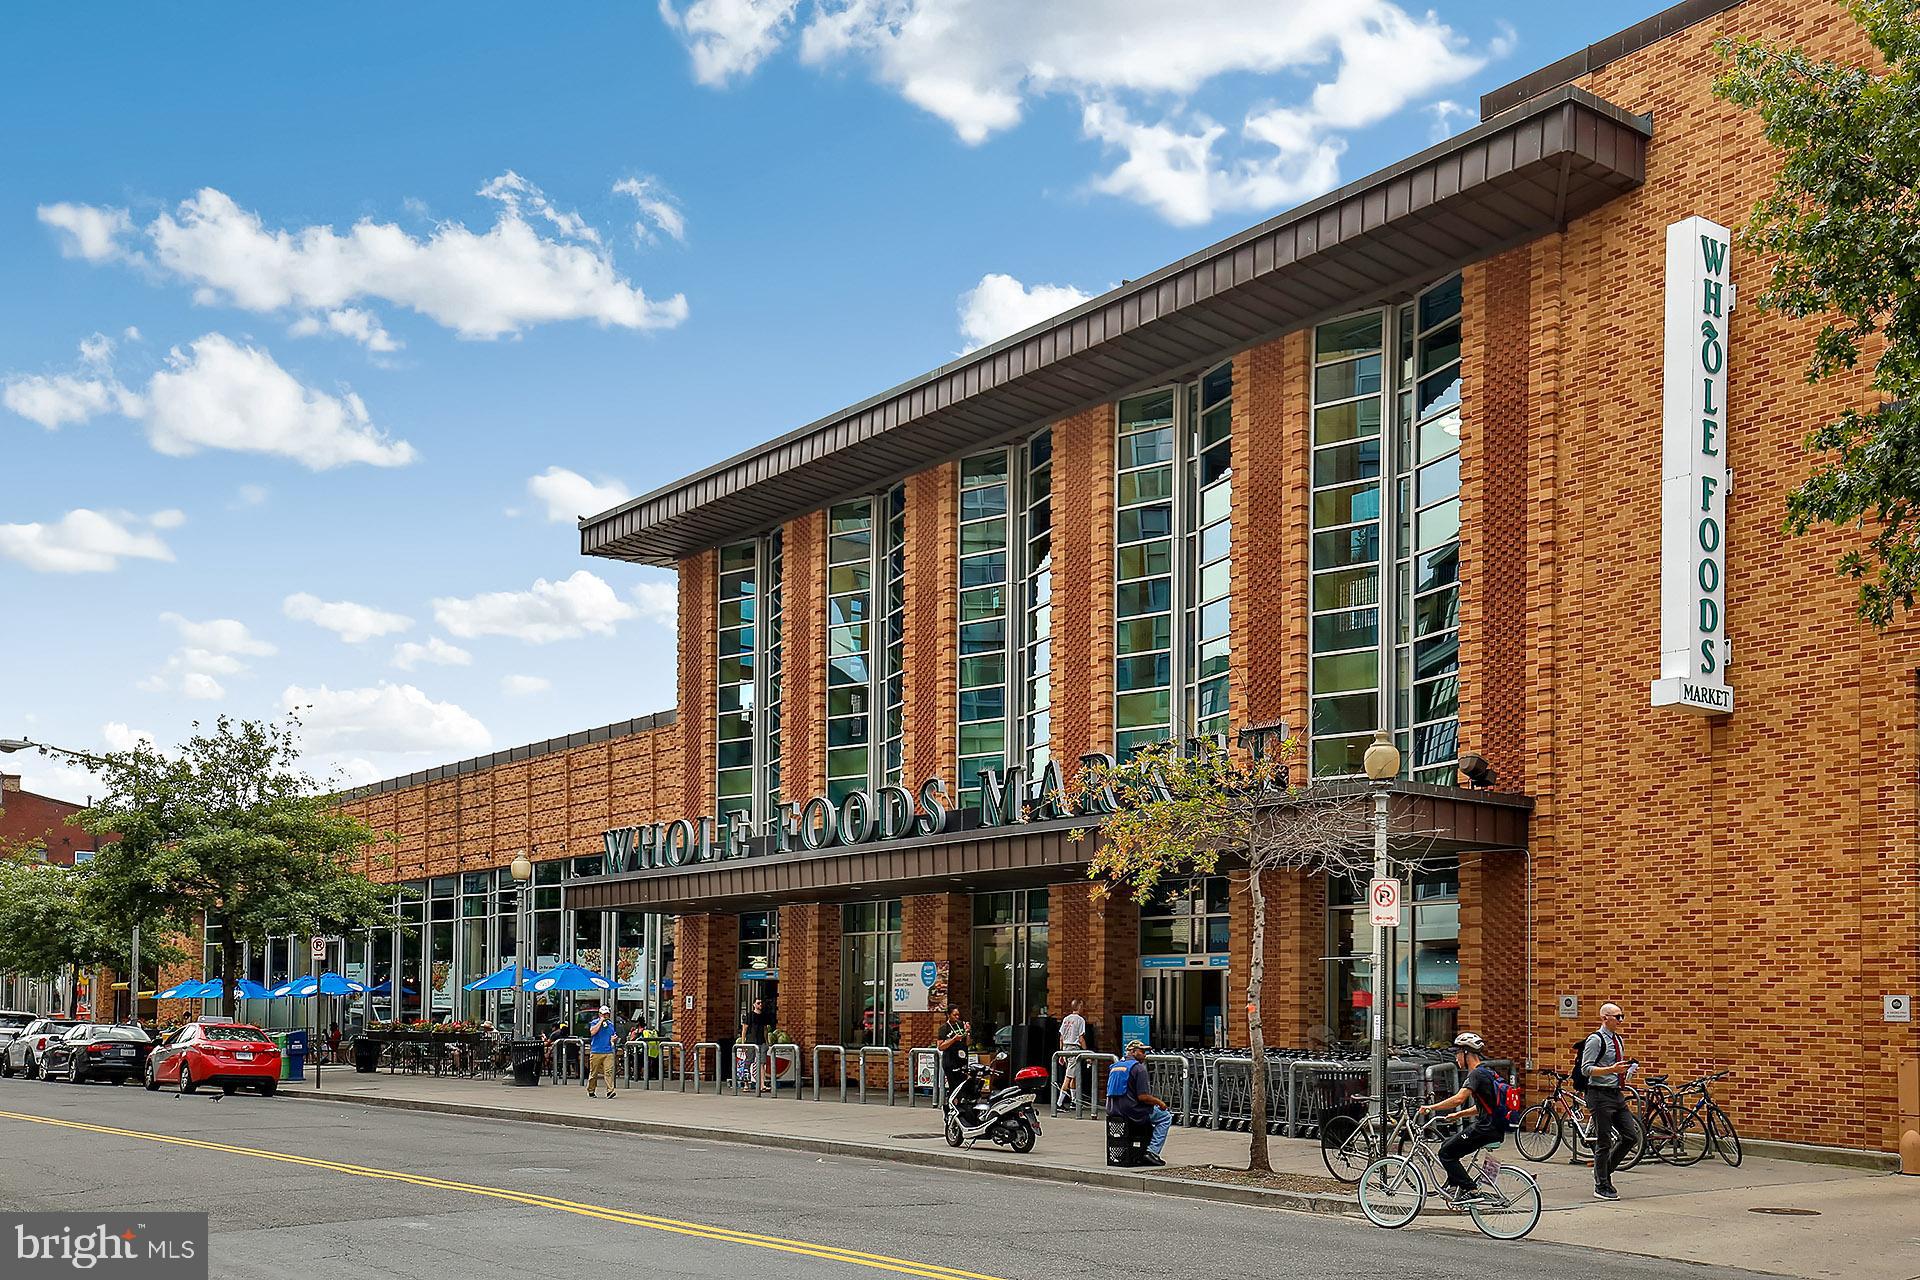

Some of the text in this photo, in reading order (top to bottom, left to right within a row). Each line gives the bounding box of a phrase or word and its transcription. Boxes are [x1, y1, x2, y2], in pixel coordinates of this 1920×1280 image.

[1698, 235, 1728, 674] WHOLE FOODS
[1683, 683, 1730, 707] MARKET
[601, 809, 750, 875] WHOLE
[776, 777, 947, 853] FOODS
